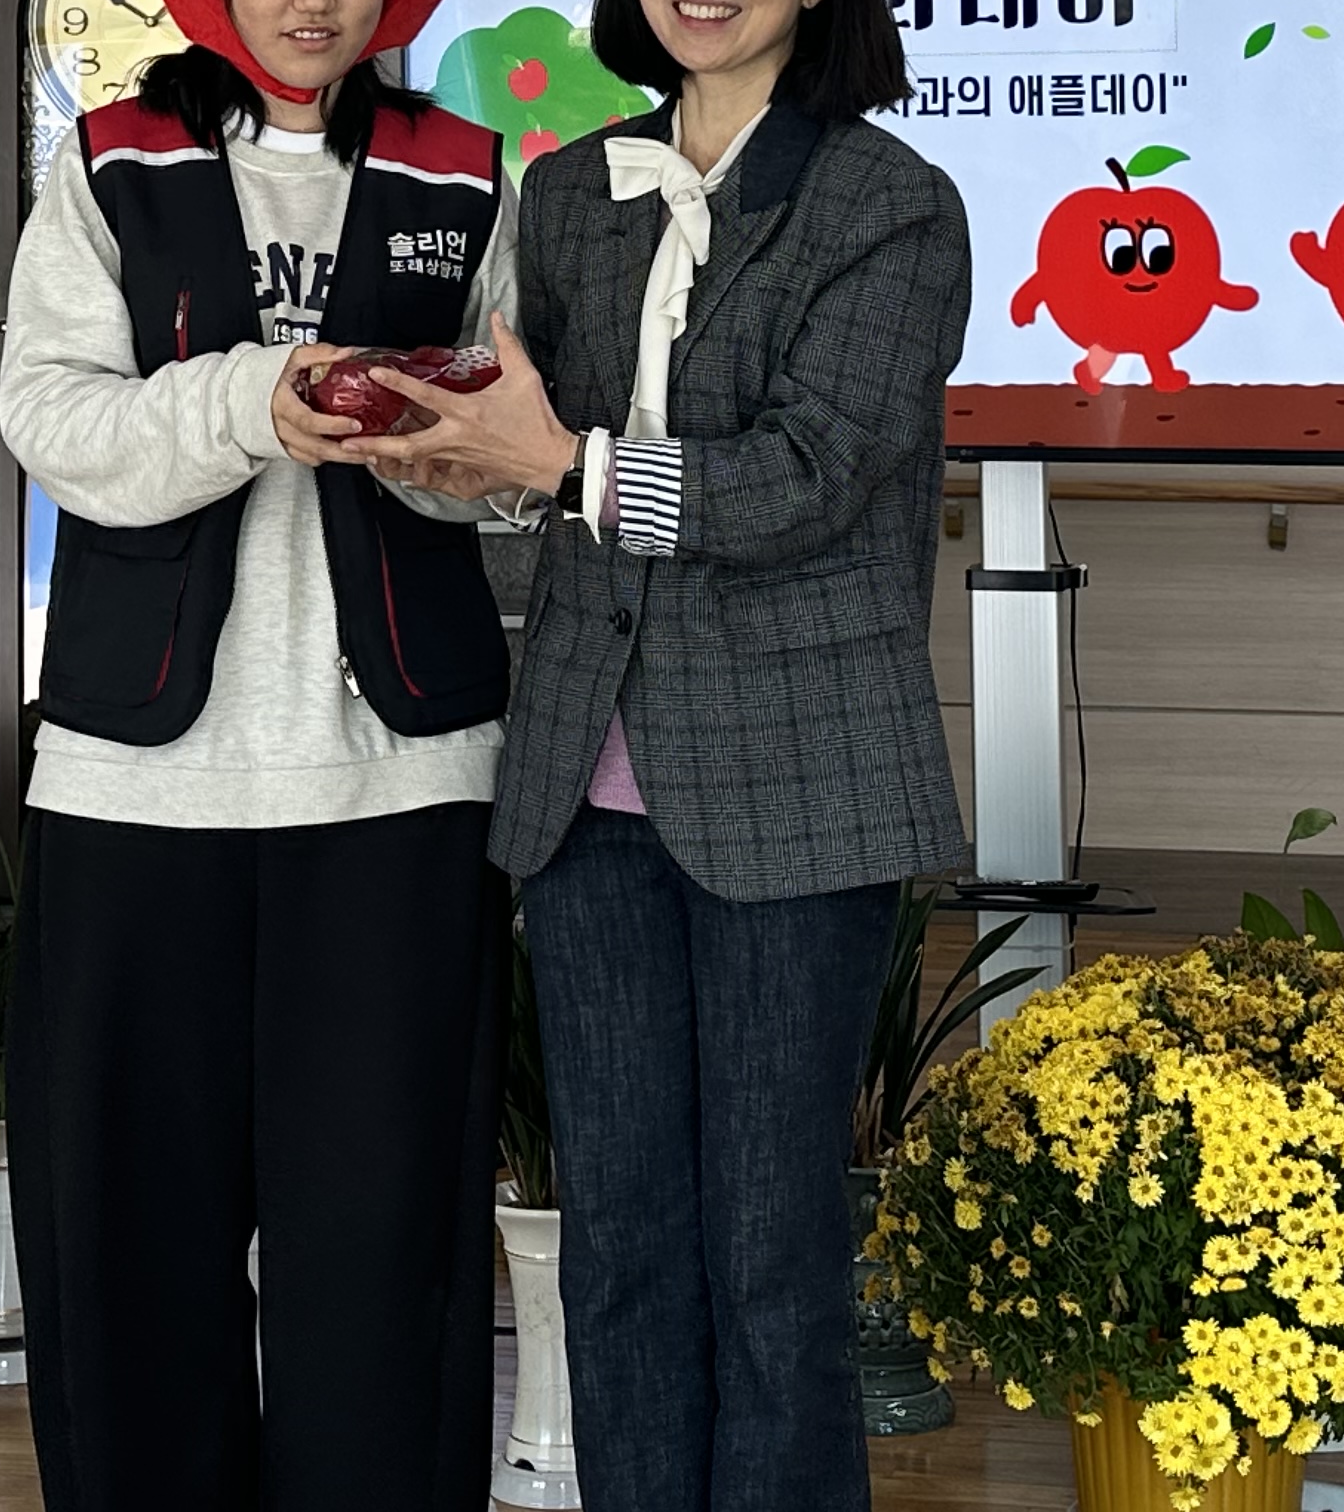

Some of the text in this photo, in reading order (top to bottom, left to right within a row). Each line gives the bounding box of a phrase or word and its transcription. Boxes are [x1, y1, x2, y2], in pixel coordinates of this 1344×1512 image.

[63, 7, 88, 35] 9
[72, 48, 100, 76] 8
[102, 83, 126, 102] 7
[1008, 73, 1188, 118] 애플데이"
[387, 229, 467, 261] 솔리언
[389, 258, 464, 282] 또래상담자
[273, 324, 319, 345] 1996
